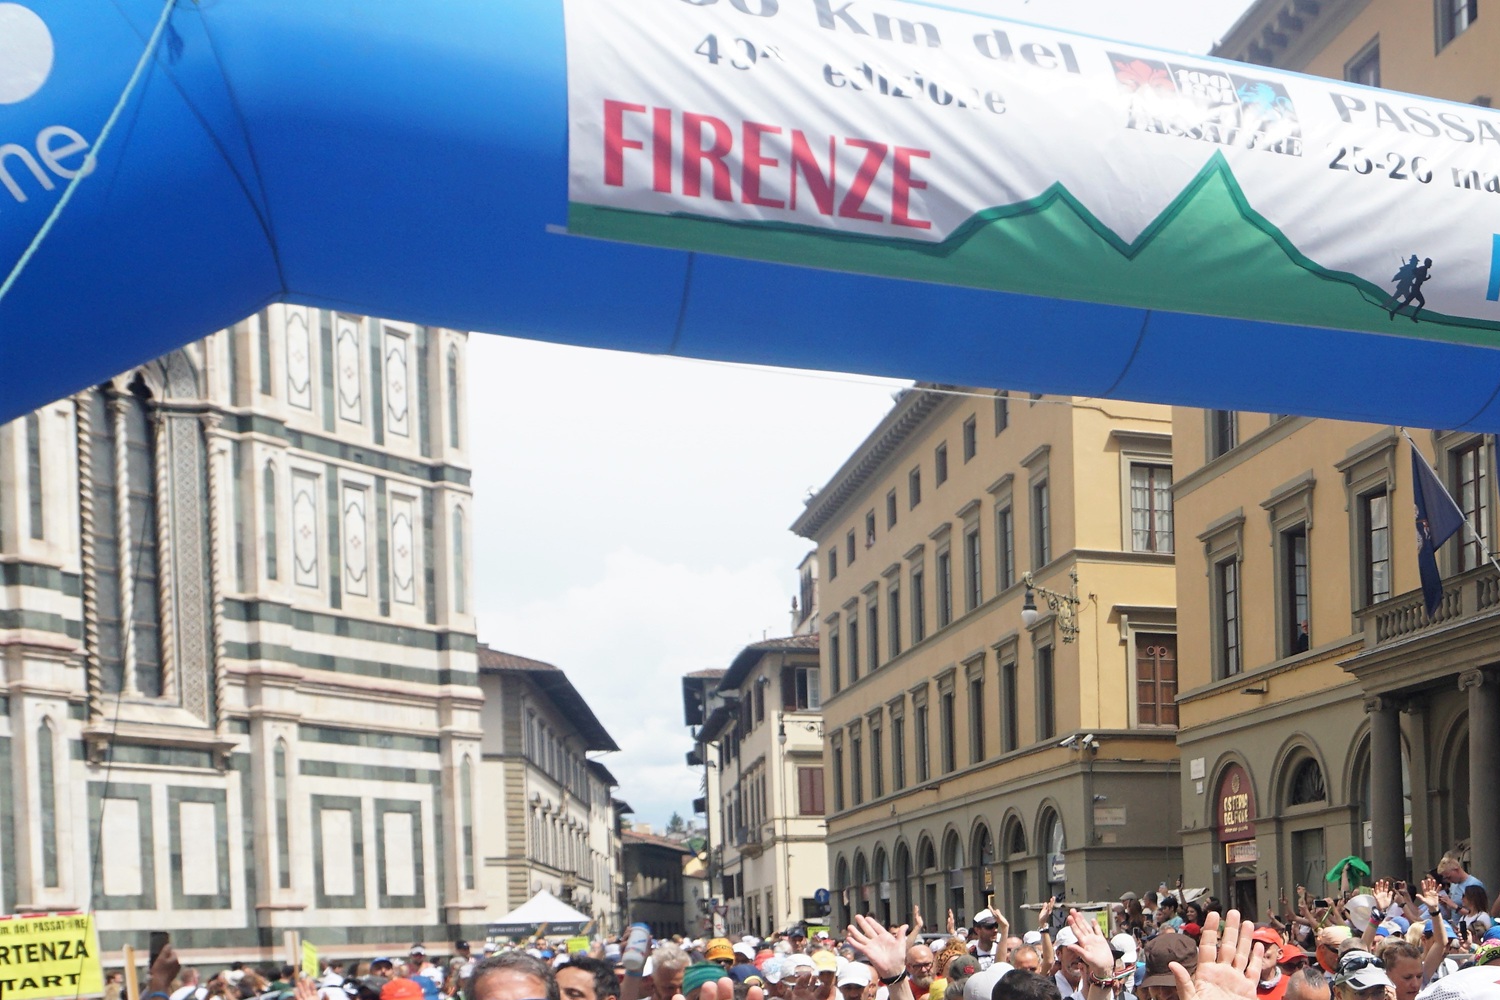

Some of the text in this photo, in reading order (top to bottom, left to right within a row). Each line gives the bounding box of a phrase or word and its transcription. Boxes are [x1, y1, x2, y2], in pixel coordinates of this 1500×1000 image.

[973, 28, 1081, 75] del
[602, 97, 932, 230] FIRENZE
[0, 940, 90, 966] RTENZA
